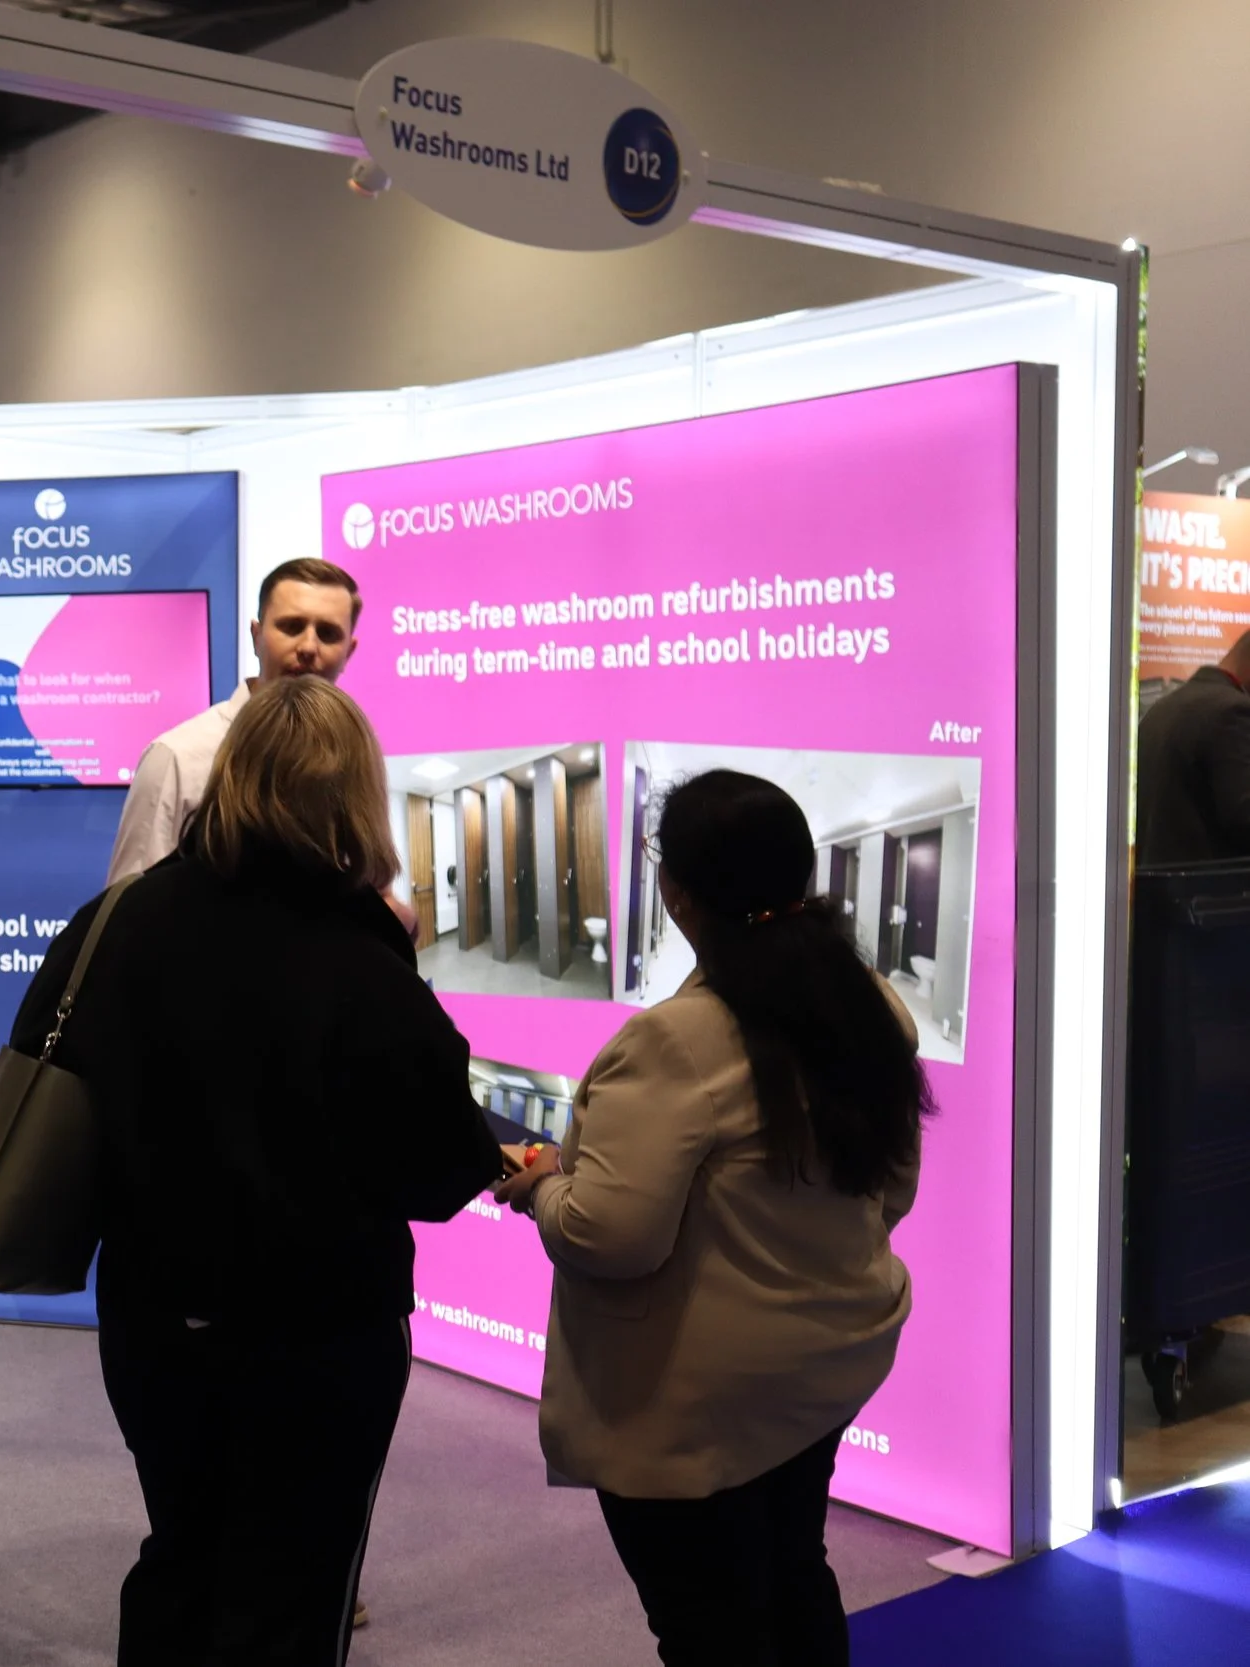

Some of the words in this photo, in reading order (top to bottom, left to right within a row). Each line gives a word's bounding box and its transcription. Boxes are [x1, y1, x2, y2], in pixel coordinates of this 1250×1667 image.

[392, 75, 462, 116] Focus
[391, 120, 528, 174] Washrooms
[535, 149, 569, 181] Ltd
[623, 147, 661, 180] D12
[459, 477, 633, 528] WASHROOMS
[1144, 507, 1226, 550] WASTE.
[1141, 550, 1183, 589] IT'S
[1187, 555, 1250, 595] PRECI
[392, 600, 516, 634] Stress-free
[521, 592, 654, 626] washroom
[661, 567, 895, 616] refurbishments
[396, 647, 467, 683] during
[473, 640, 595, 674] term-time
[601, 634, 650, 667] and
[657, 628, 751, 666] school
[759, 622, 890, 664] holidays
[0, 695, 8, 706] a
[10, 692, 80, 706] washroom
[83, 690, 161, 705] contractor?
[39, 673, 69, 687] look
[71, 673, 91, 686] for
[94, 672, 132, 686] when
[930, 720, 982, 743] After
[464, 1198, 502, 1222] efore
[430, 1301, 525, 1345] washrooms
[528, 1331, 546, 1351] re
